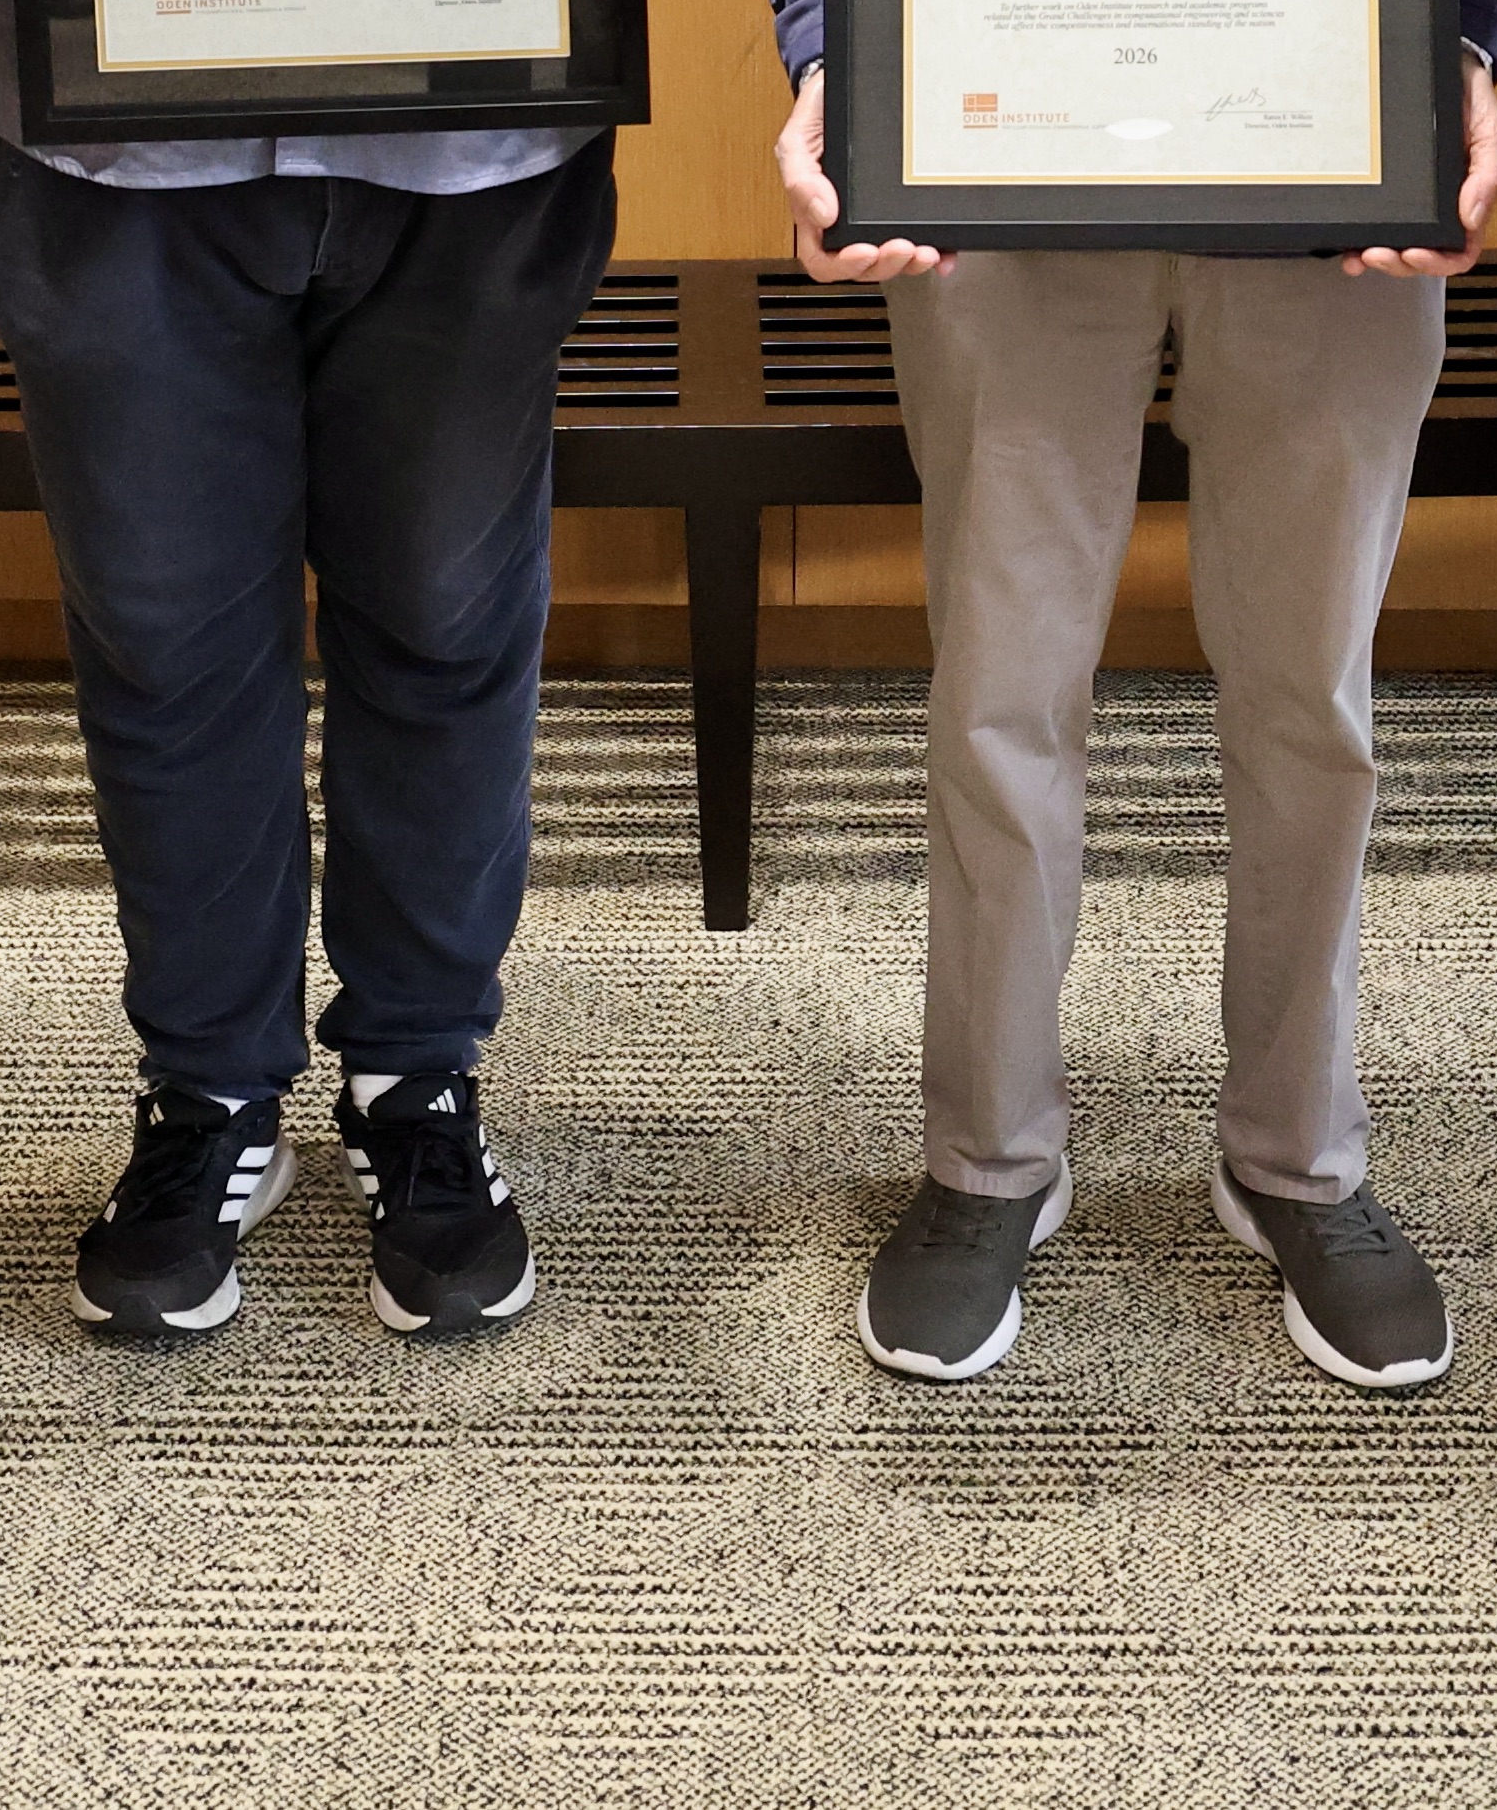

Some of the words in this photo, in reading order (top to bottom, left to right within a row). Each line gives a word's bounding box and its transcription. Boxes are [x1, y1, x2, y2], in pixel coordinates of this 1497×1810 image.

[1113, 48, 1157, 65] 2026
[963, 113, 998, 123] ODEN
[1002, 112, 1069, 122] INSTITUTE
